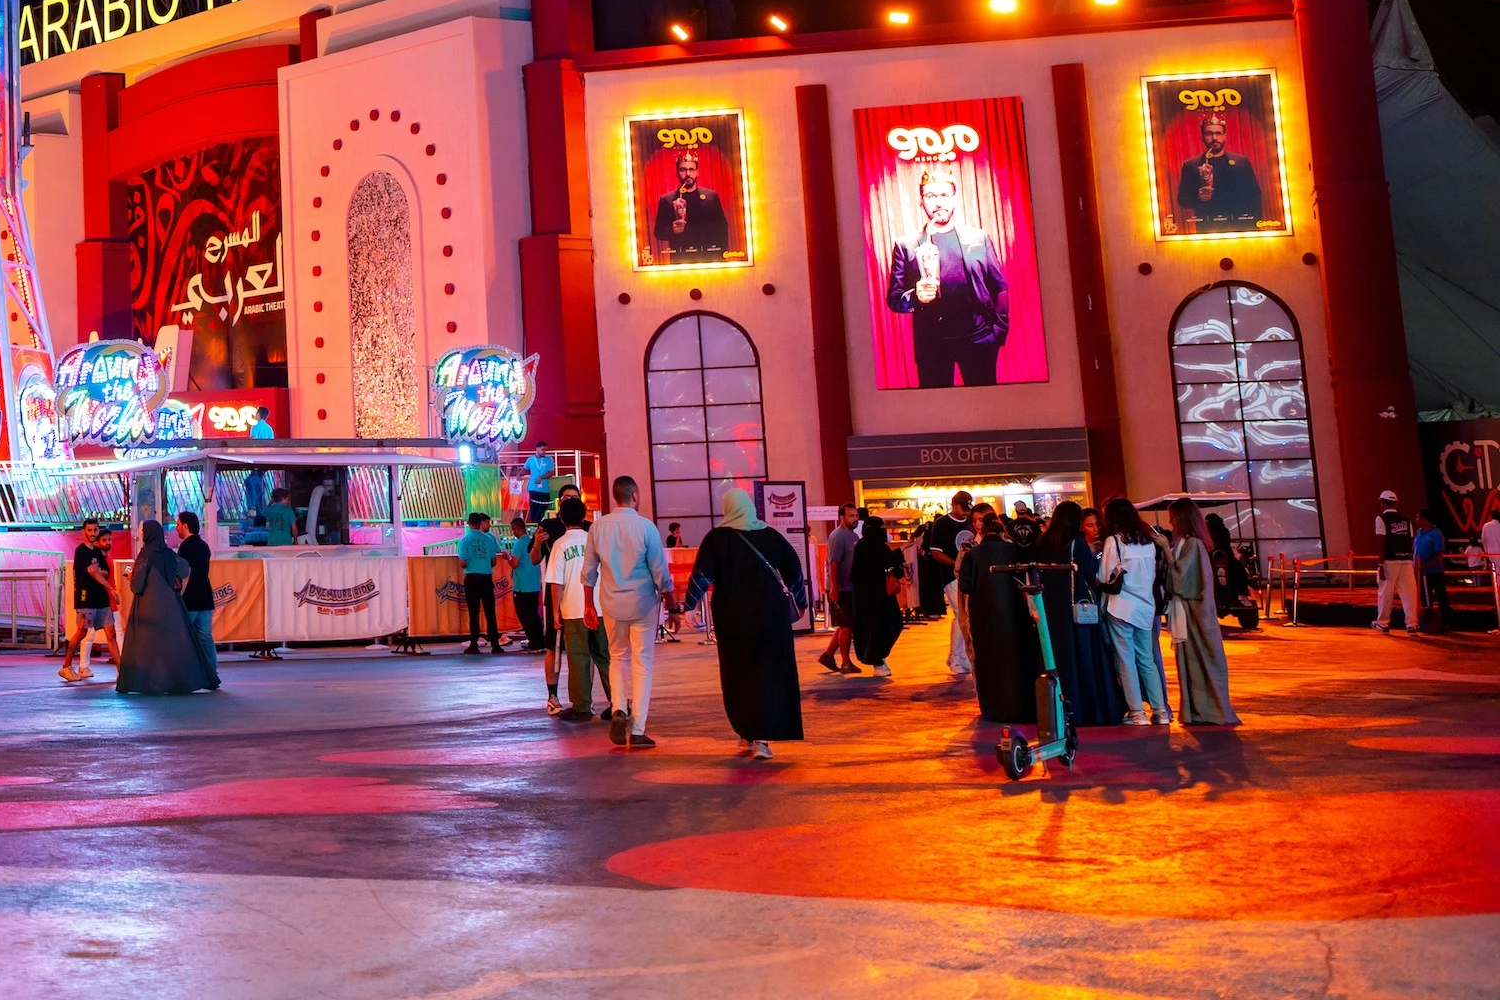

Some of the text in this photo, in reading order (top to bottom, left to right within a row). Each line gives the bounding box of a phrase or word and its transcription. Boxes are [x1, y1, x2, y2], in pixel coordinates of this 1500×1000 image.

[204, 209, 261, 264] المسرح
[171, 231, 284, 328] لعربي
[243, 300, 286, 315] ARABIC THEAT
[56, 349, 159, 392] Around
[437, 352, 526, 396] Around
[102, 379, 134, 403] the
[477, 382, 505, 402] the
[920, 445, 1015, 464] BOX OFFICE
[352, 579, 376, 599] RIDES
